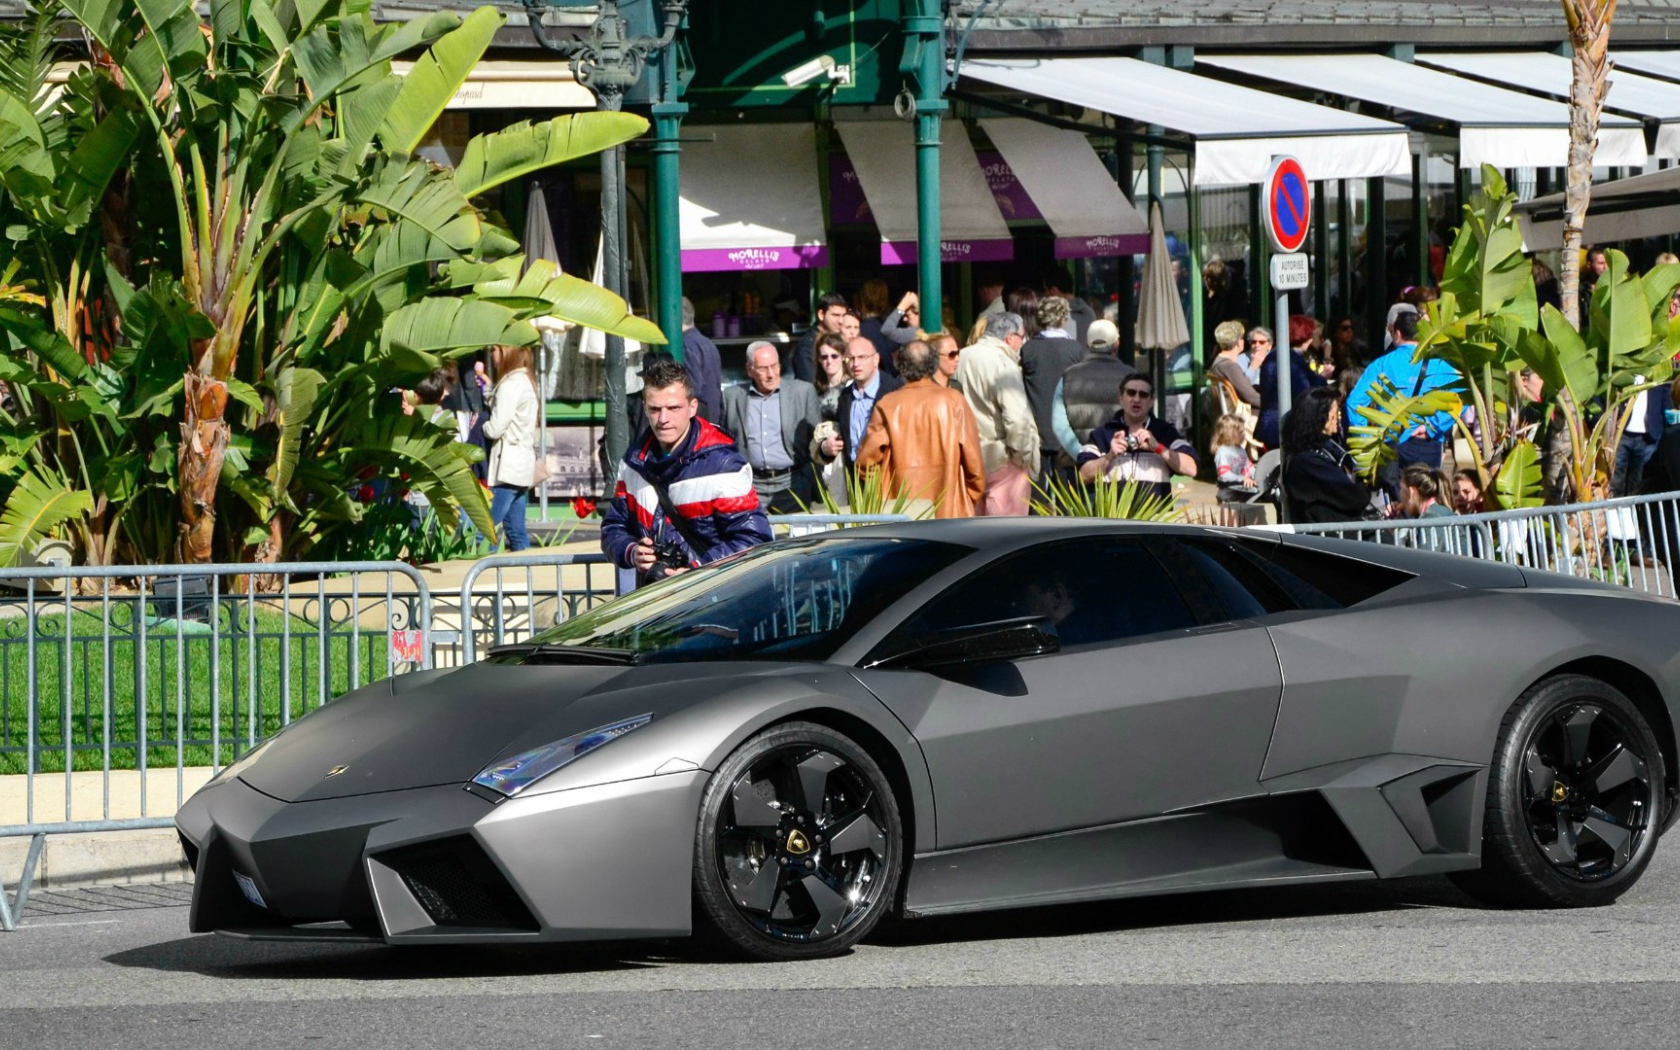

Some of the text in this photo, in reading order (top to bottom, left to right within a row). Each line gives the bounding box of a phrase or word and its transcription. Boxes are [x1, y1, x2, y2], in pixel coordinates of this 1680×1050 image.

[454, 82, 486, 105] hopard
[941, 241, 971, 254] RELLI'S
[728, 249, 780, 263] MORELLI'S
[1279, 272, 1307, 284] 10 MINUTES
